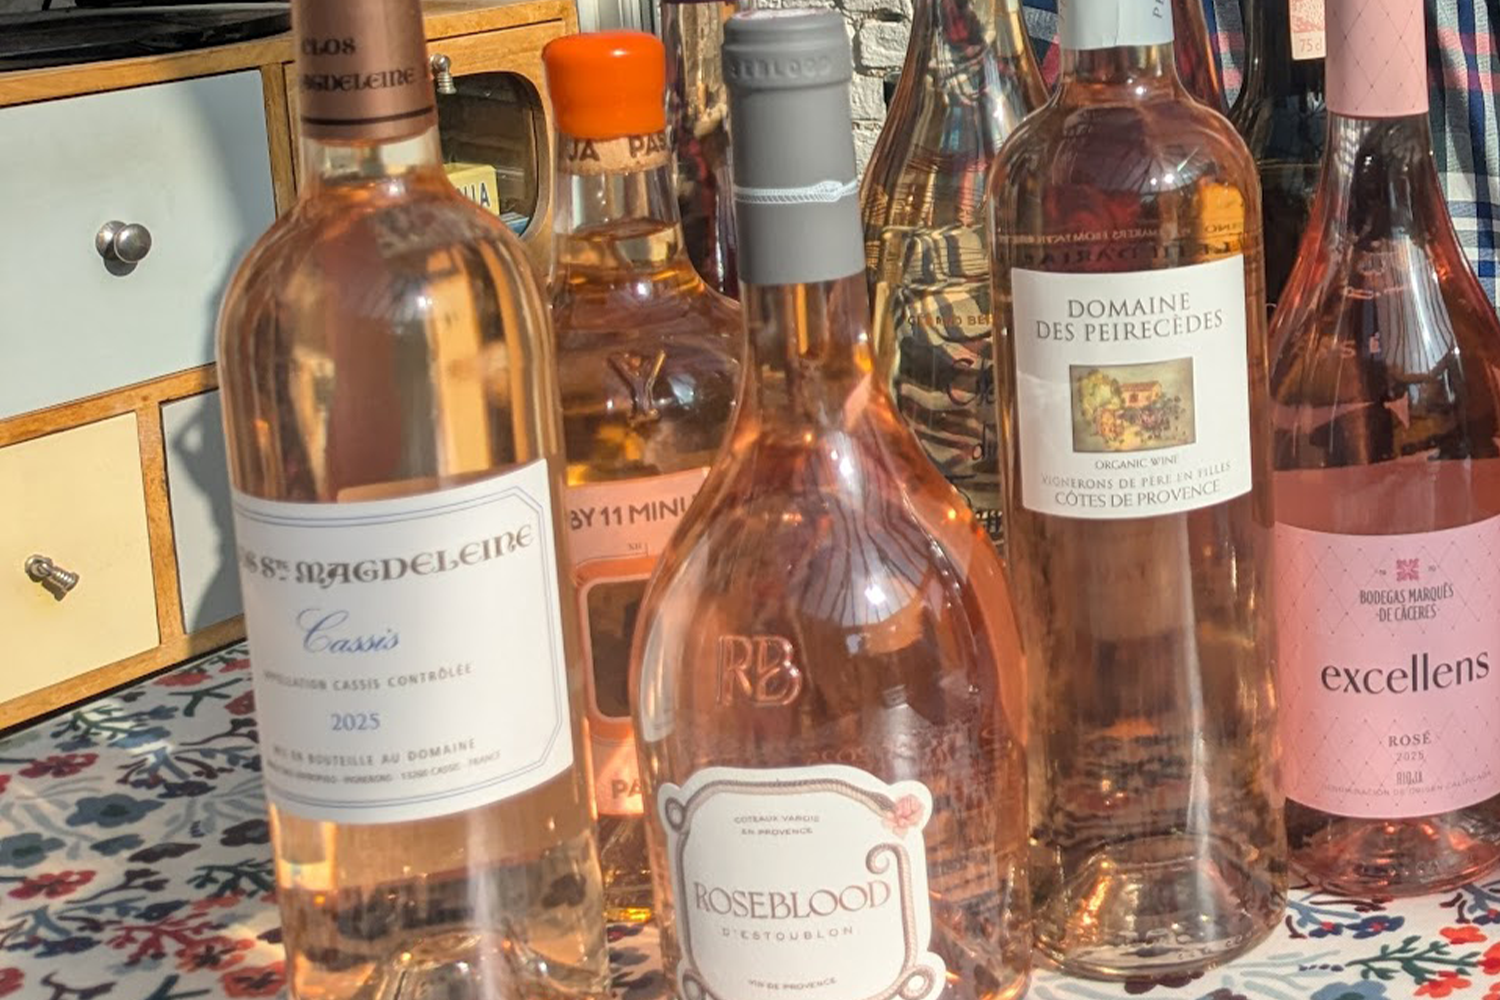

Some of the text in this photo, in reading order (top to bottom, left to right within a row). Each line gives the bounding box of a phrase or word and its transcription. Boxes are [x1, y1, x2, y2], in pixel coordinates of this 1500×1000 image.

[302, 37, 357, 56] CLOS
[1068, 293, 1191, 318] DOMAINE
[1037, 310, 1224, 341] DES PEIRECÈDES
[1095, 455, 1178, 470] ORGANIC WINE
[1041, 473, 1114, 489] VIGNERONS
[1119, 478, 1136, 489] DE
[1177, 469, 1192, 482] EN
[1055, 479, 1220, 508] CÔTES DE PROVENCE
[296, 524, 534, 589] MAGDELEINE
[1360, 589, 1406, 605] BODEGAS
[1379, 607, 1393, 622] DE
[297, 607, 400, 655] Cassis
[333, 678, 381, 692] CASSIS
[388, 661, 472, 688] CONTRÔLÉE
[1321, 652, 1490, 694] excellens
[330, 712, 381, 731] 2025
[1388, 731, 1432, 747] ROSÉ
[308, 753, 373, 766] BOUTEILLE
[381, 753, 400, 765] AU
[407, 738, 476, 761] DOMAINE
[1396, 751, 1424, 761] 2025
[1396, 771, 1423, 785] RIOJA
[758, 827, 813, 836] PROVENCE
[694, 880, 891, 919] ROSEBLOOD
[723, 926, 853, 941] D'ESTOUBLON
[783, 977, 837, 990] PROVENCE
